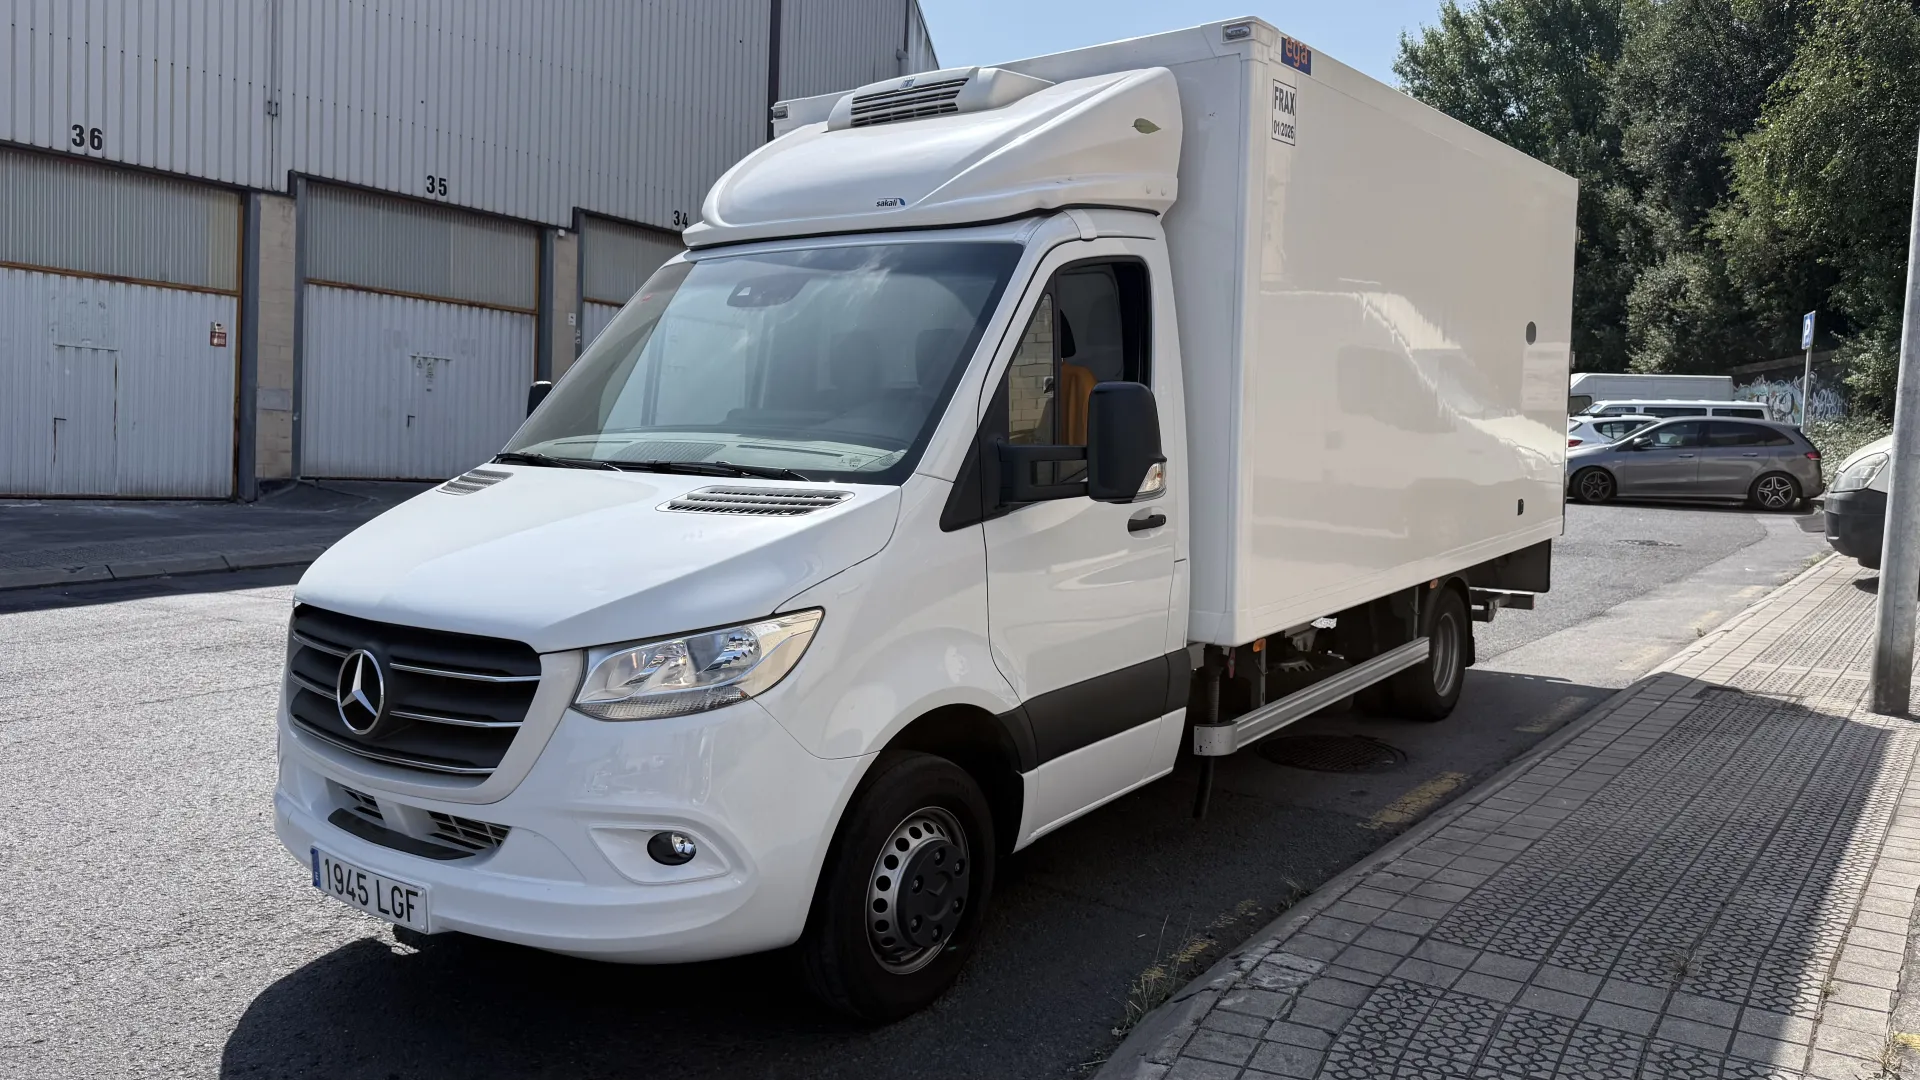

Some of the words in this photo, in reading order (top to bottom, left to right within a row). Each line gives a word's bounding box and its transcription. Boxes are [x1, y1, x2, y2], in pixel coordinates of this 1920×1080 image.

[1285, 36, 1308, 68] ega
[1274, 86, 1295, 116] FRAX
[71, 124, 103, 151] 36
[426, 174, 448, 197] 35
[673, 210, 688, 229] 34
[1804, 318, 1811, 346] P
[324, 858, 369, 906] 1945
[375, 879, 419, 923] LGF
